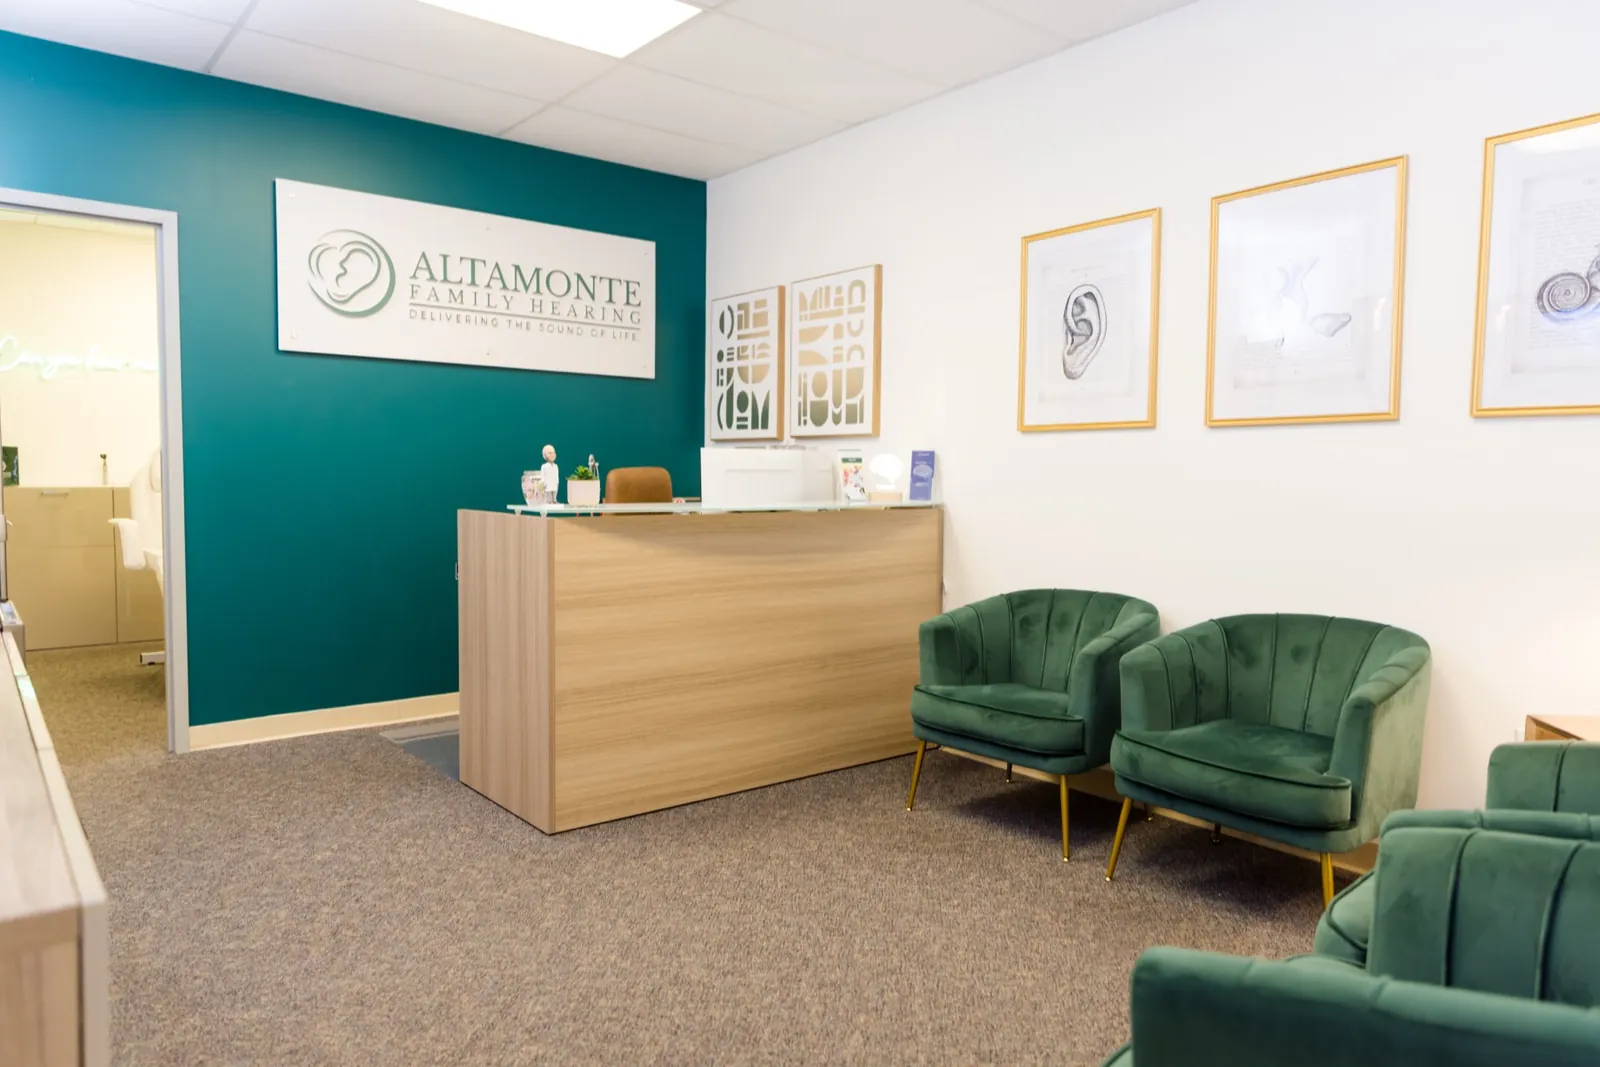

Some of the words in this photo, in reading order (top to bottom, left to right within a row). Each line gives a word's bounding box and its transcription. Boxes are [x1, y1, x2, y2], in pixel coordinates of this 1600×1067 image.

[410, 251, 641, 307] ALTAMONTE
[409, 309, 499, 328] DELIVERING
[507, 320, 532, 331] THE
[538, 323, 584, 337] SOUND
[590, 328, 607, 339] OF
[612, 330, 638, 341] LIFE
[410, 284, 514, 310] FAMILY
[531, 299, 641, 325] HEARING
